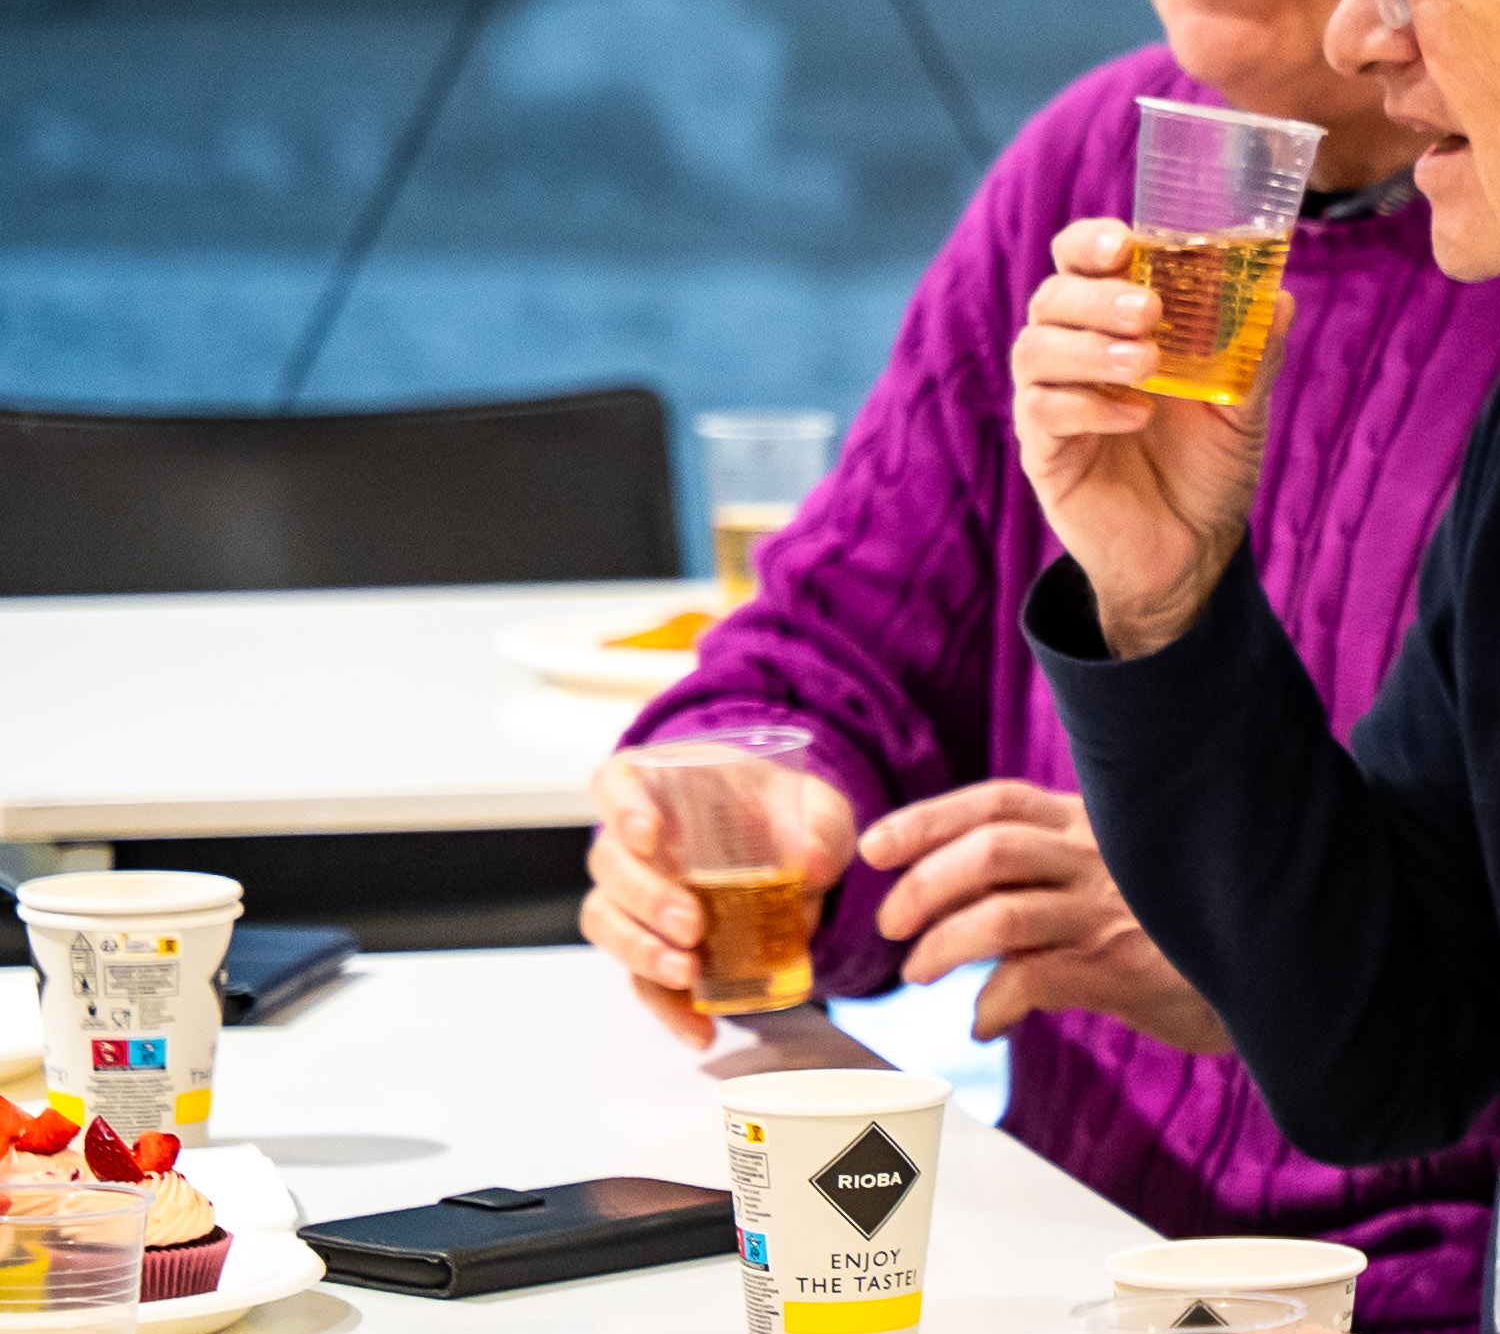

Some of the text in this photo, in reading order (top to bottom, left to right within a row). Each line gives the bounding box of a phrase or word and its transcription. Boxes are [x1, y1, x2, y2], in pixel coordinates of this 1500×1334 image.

[837, 1171, 903, 1189] RIOBA
[831, 1248, 901, 1273] ENJOY
[795, 1268, 917, 1294] THE TASTE!
